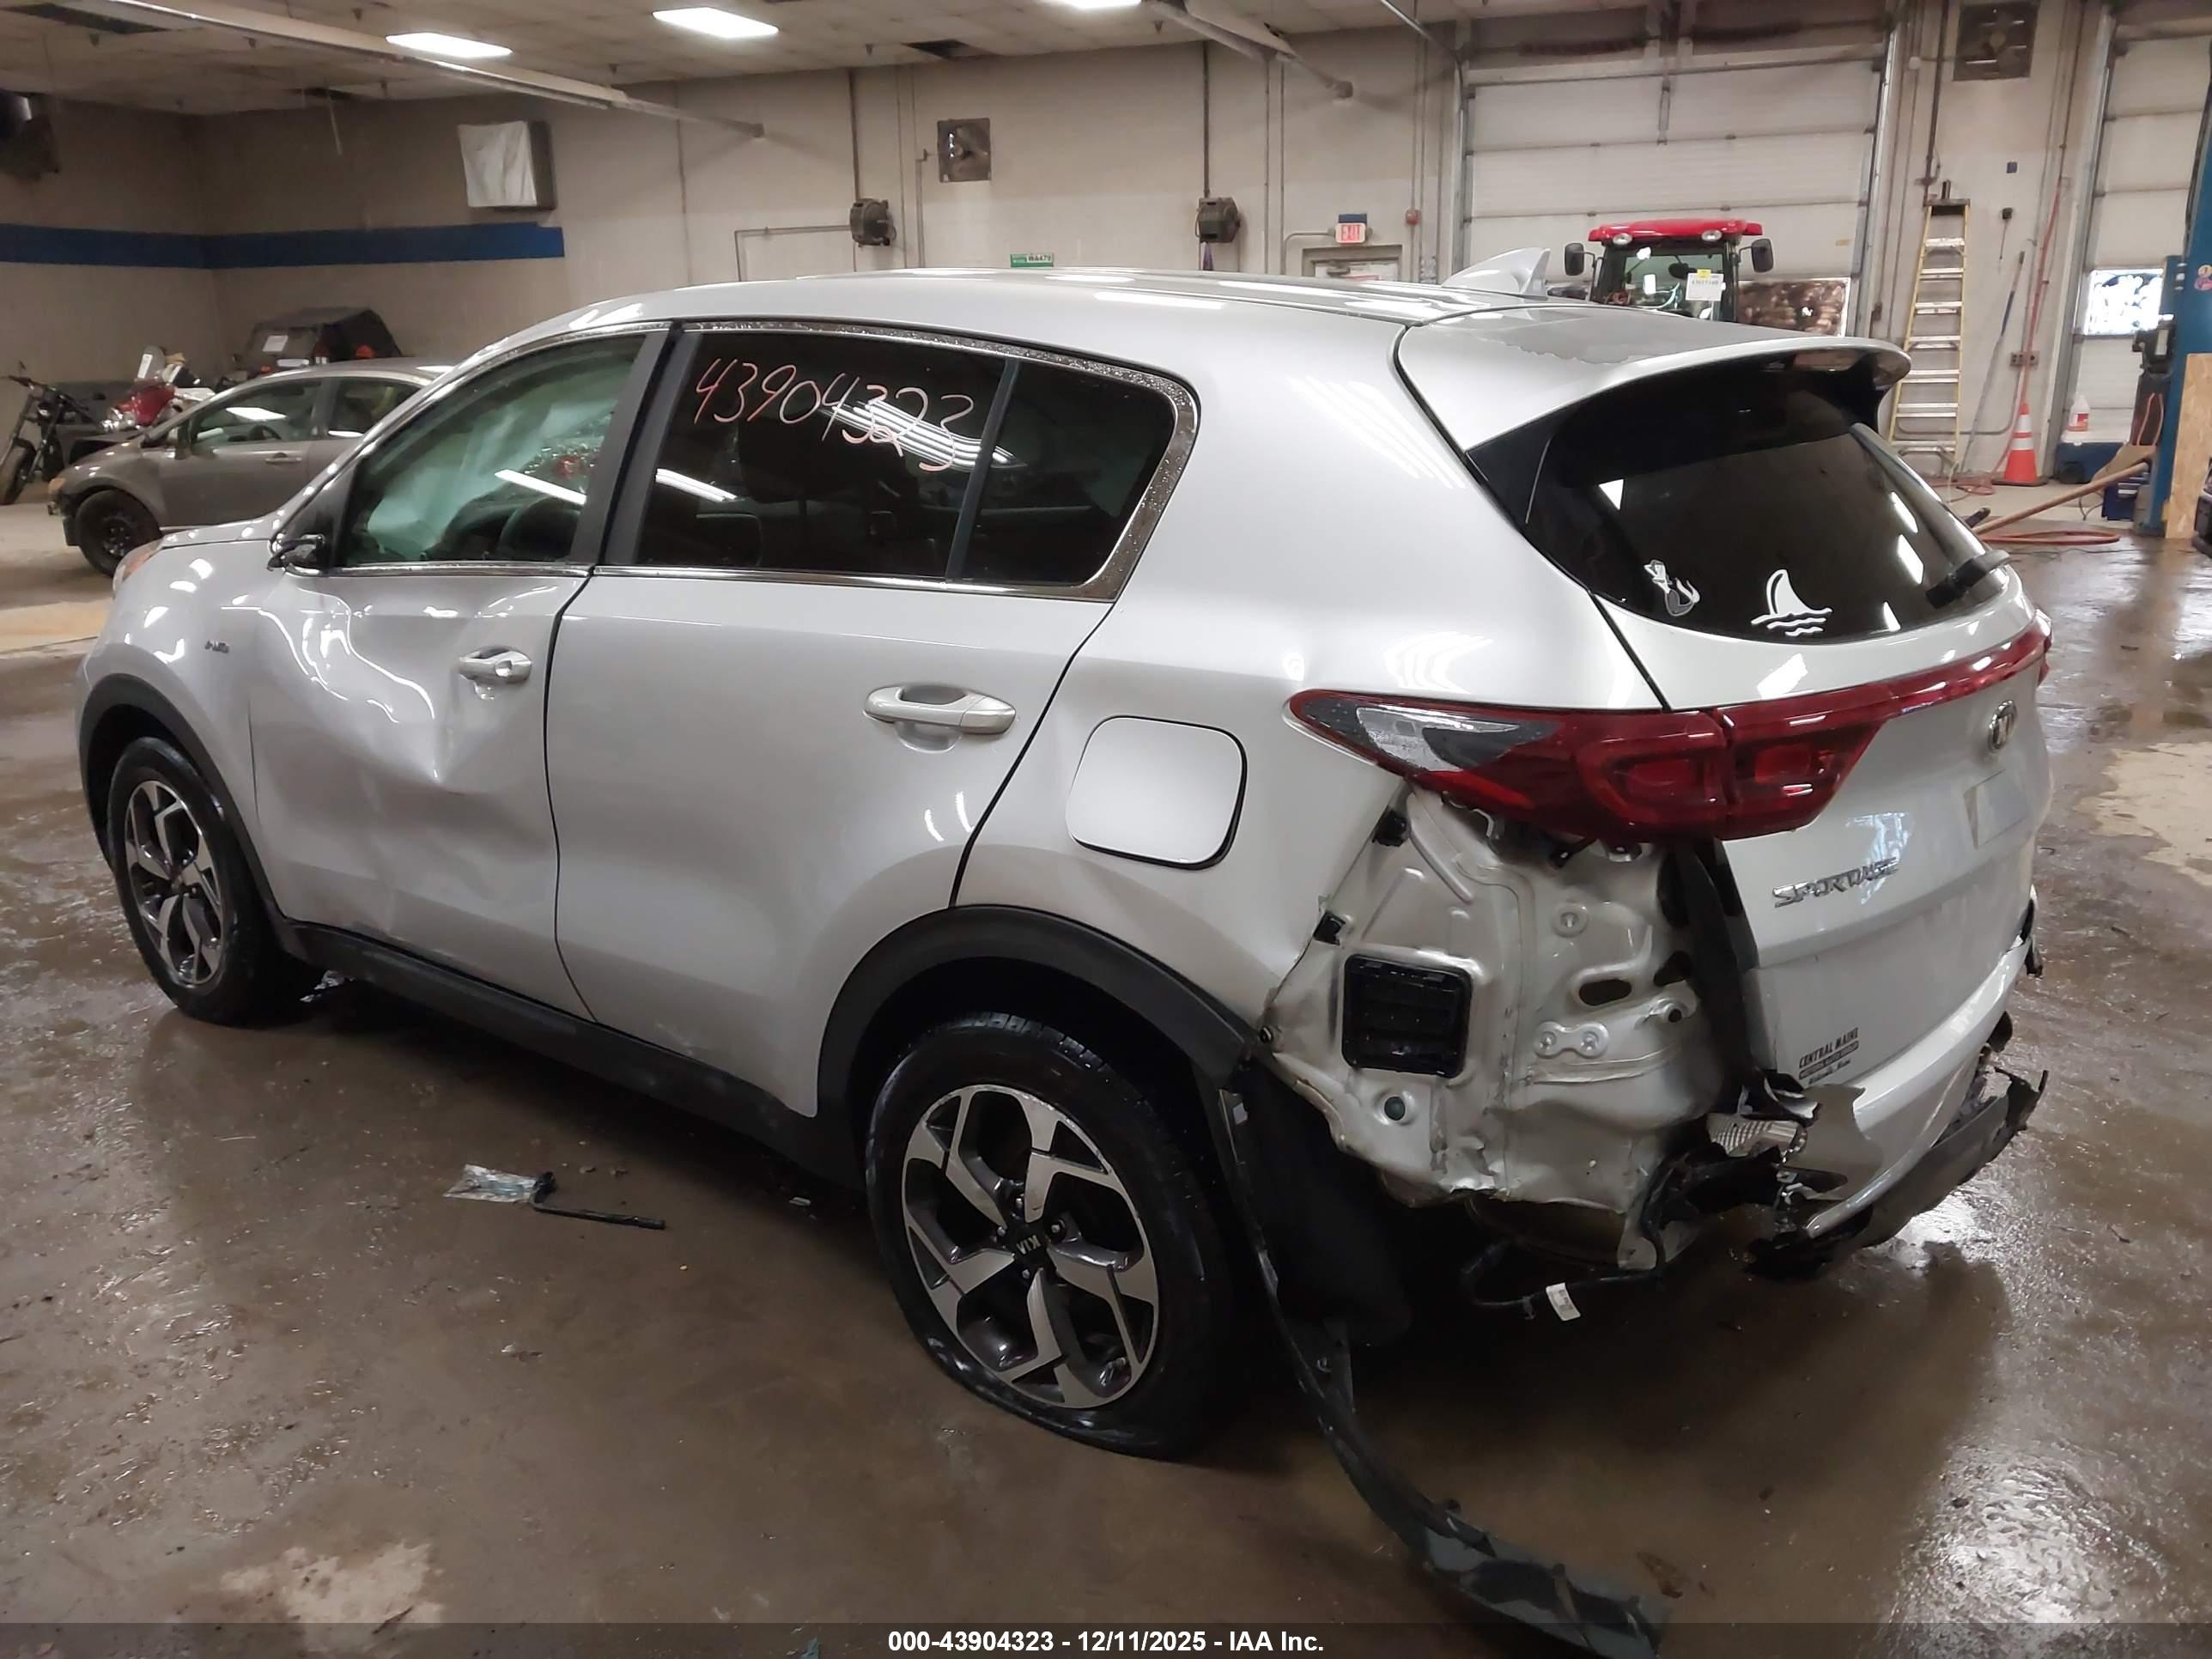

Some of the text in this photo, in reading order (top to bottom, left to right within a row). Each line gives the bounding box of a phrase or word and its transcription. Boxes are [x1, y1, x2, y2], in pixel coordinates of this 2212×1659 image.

[694, 358, 975, 472] 43904323
[1771, 857, 1900, 908] SPORTAGE
[1799, 1042, 1833, 1069] CENTRAL
[1834, 1026, 1859, 1050] MAINE
[1016, 1234, 1042, 1255] KIA
